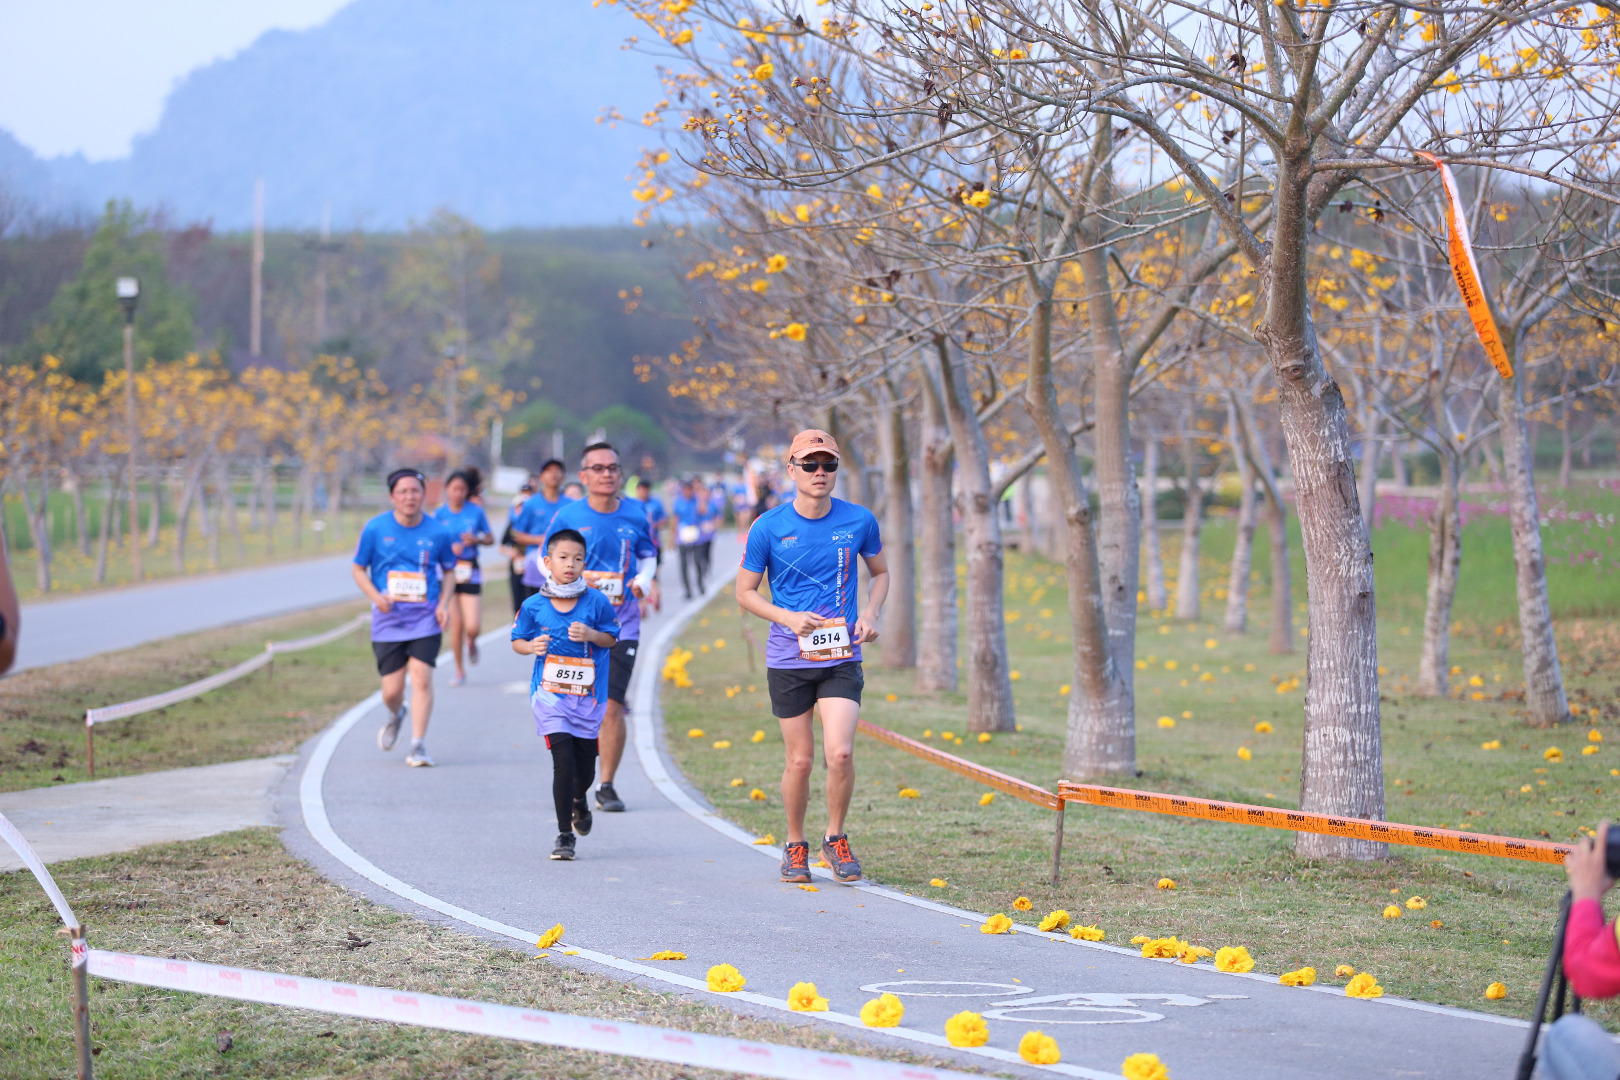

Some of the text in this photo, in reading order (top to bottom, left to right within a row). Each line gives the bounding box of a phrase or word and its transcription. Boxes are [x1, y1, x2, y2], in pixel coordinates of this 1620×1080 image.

[1453, 264, 1474, 308] SINGHA
[1458, 260, 1481, 306] SERIES
[812, 632, 841, 646] 8514
[556, 669, 584, 681] 8515
[1208, 802, 1226, 812] SINGHA
[1247, 808, 1264, 816] SINGHA
[1286, 814, 1304, 822] SINGHA
[1328, 818, 1346, 826] SINGHA
[1287, 820, 1306, 830] SERIES
[1328, 825, 1348, 835] SERIES
[1370, 824, 1388, 832] SINGHA
[1370, 831, 1390, 841] SERIES
[1414, 829, 1434, 838] SINGHA
[1414, 837, 1435, 847] SERIES
[1458, 834, 1479, 844] SINGHA
[1459, 842, 1480, 852] SERIES
[1505, 840, 1526, 850] SINGHA
[1506, 848, 1528, 858] SERIES
